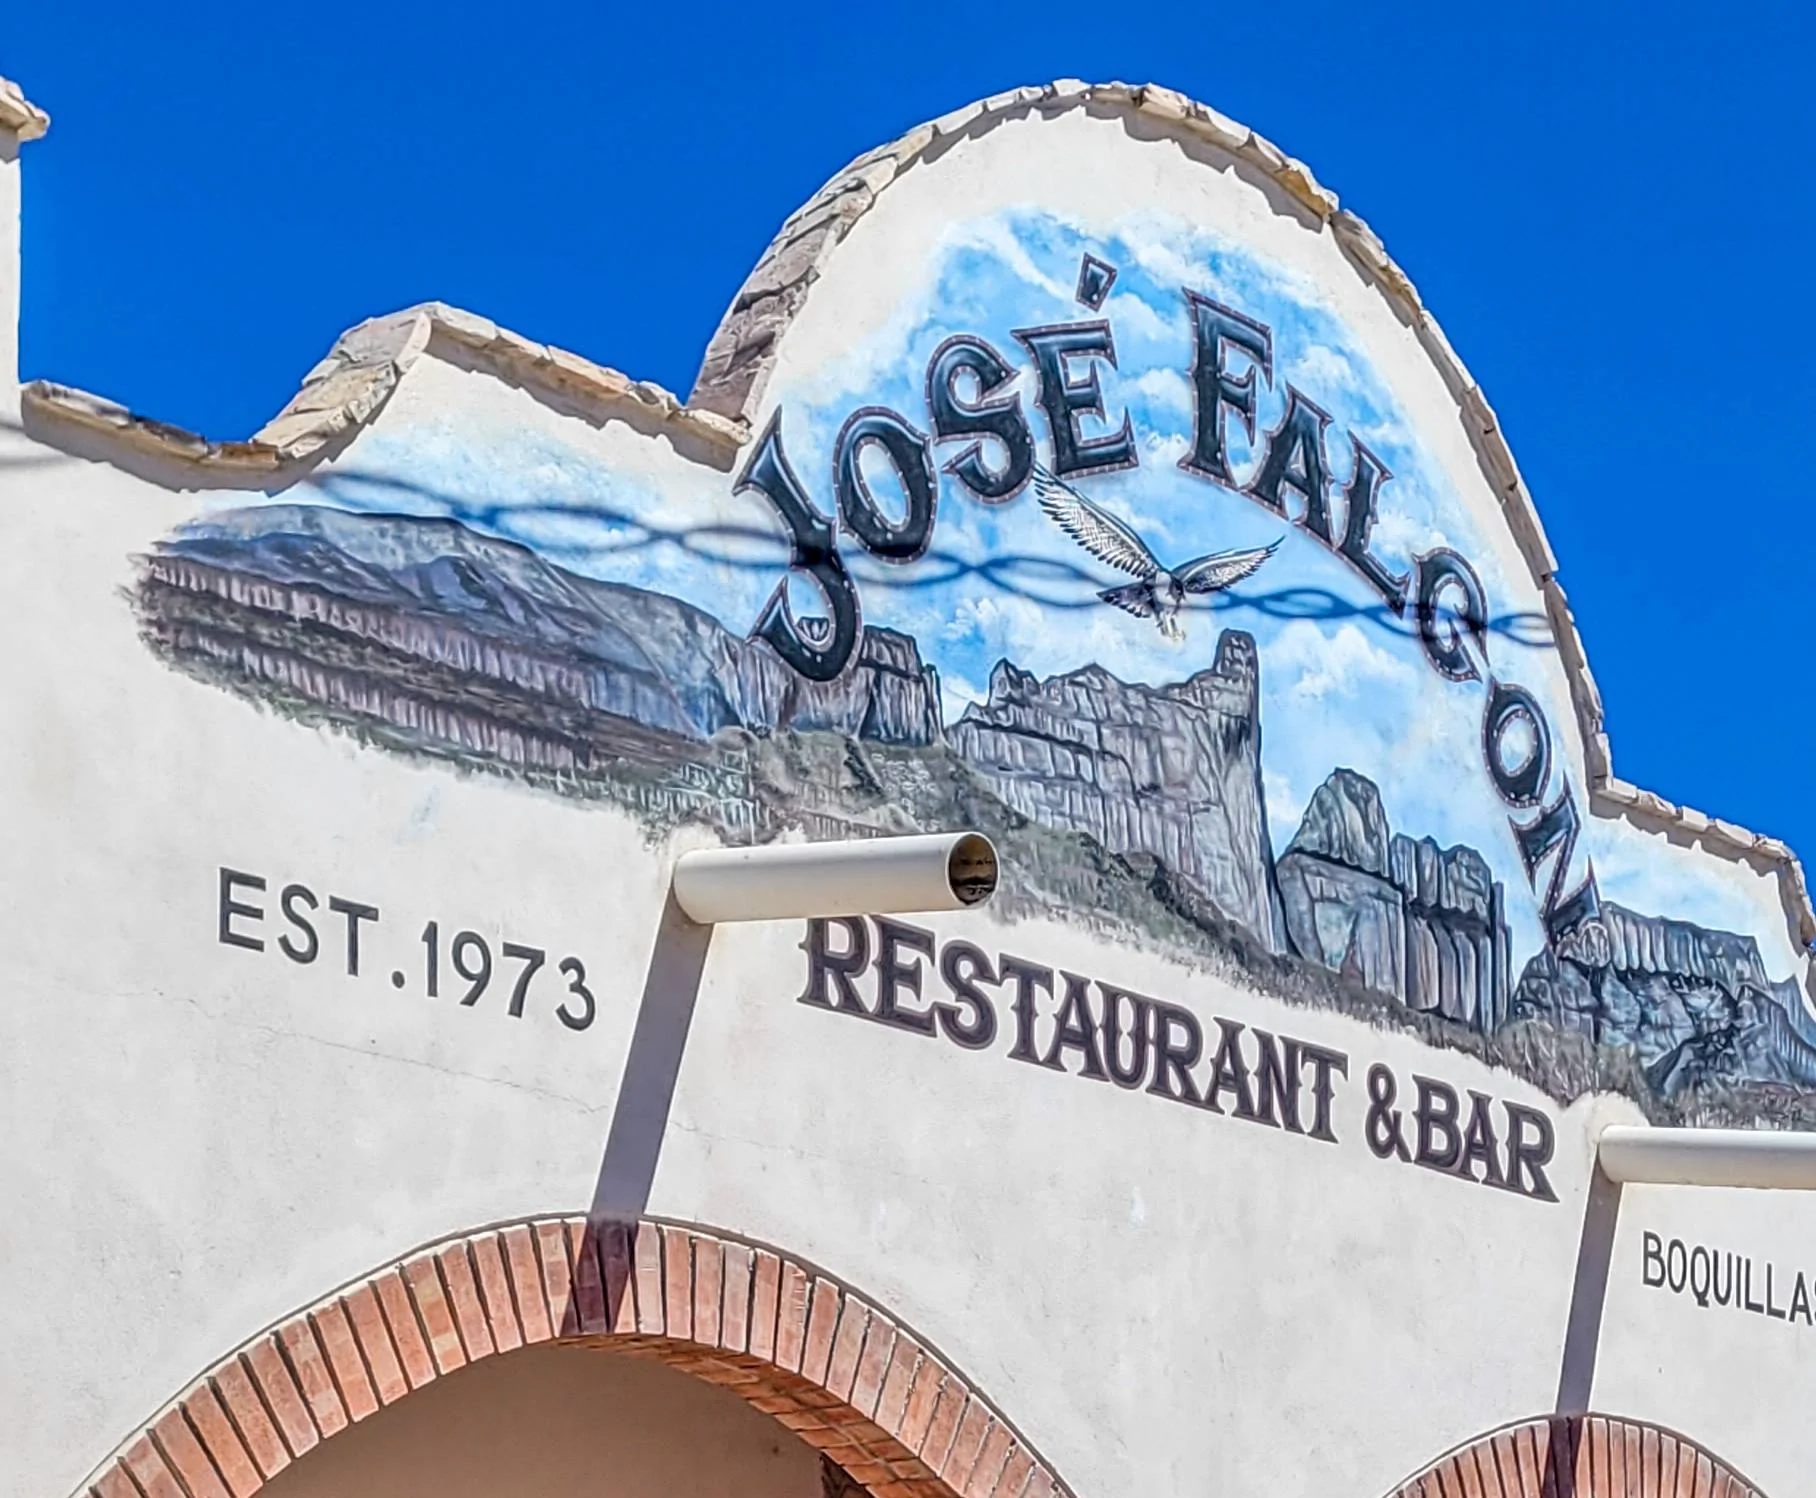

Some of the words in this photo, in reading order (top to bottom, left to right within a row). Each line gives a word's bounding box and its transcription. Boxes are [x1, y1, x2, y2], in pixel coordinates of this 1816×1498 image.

[734, 253, 1139, 682] JOSÉ
[1178, 286, 1601, 953] FALCON
[797, 915, 1349, 1144] RESTAURANT
[1642, 1230, 1816, 1326] BOQUILLA
